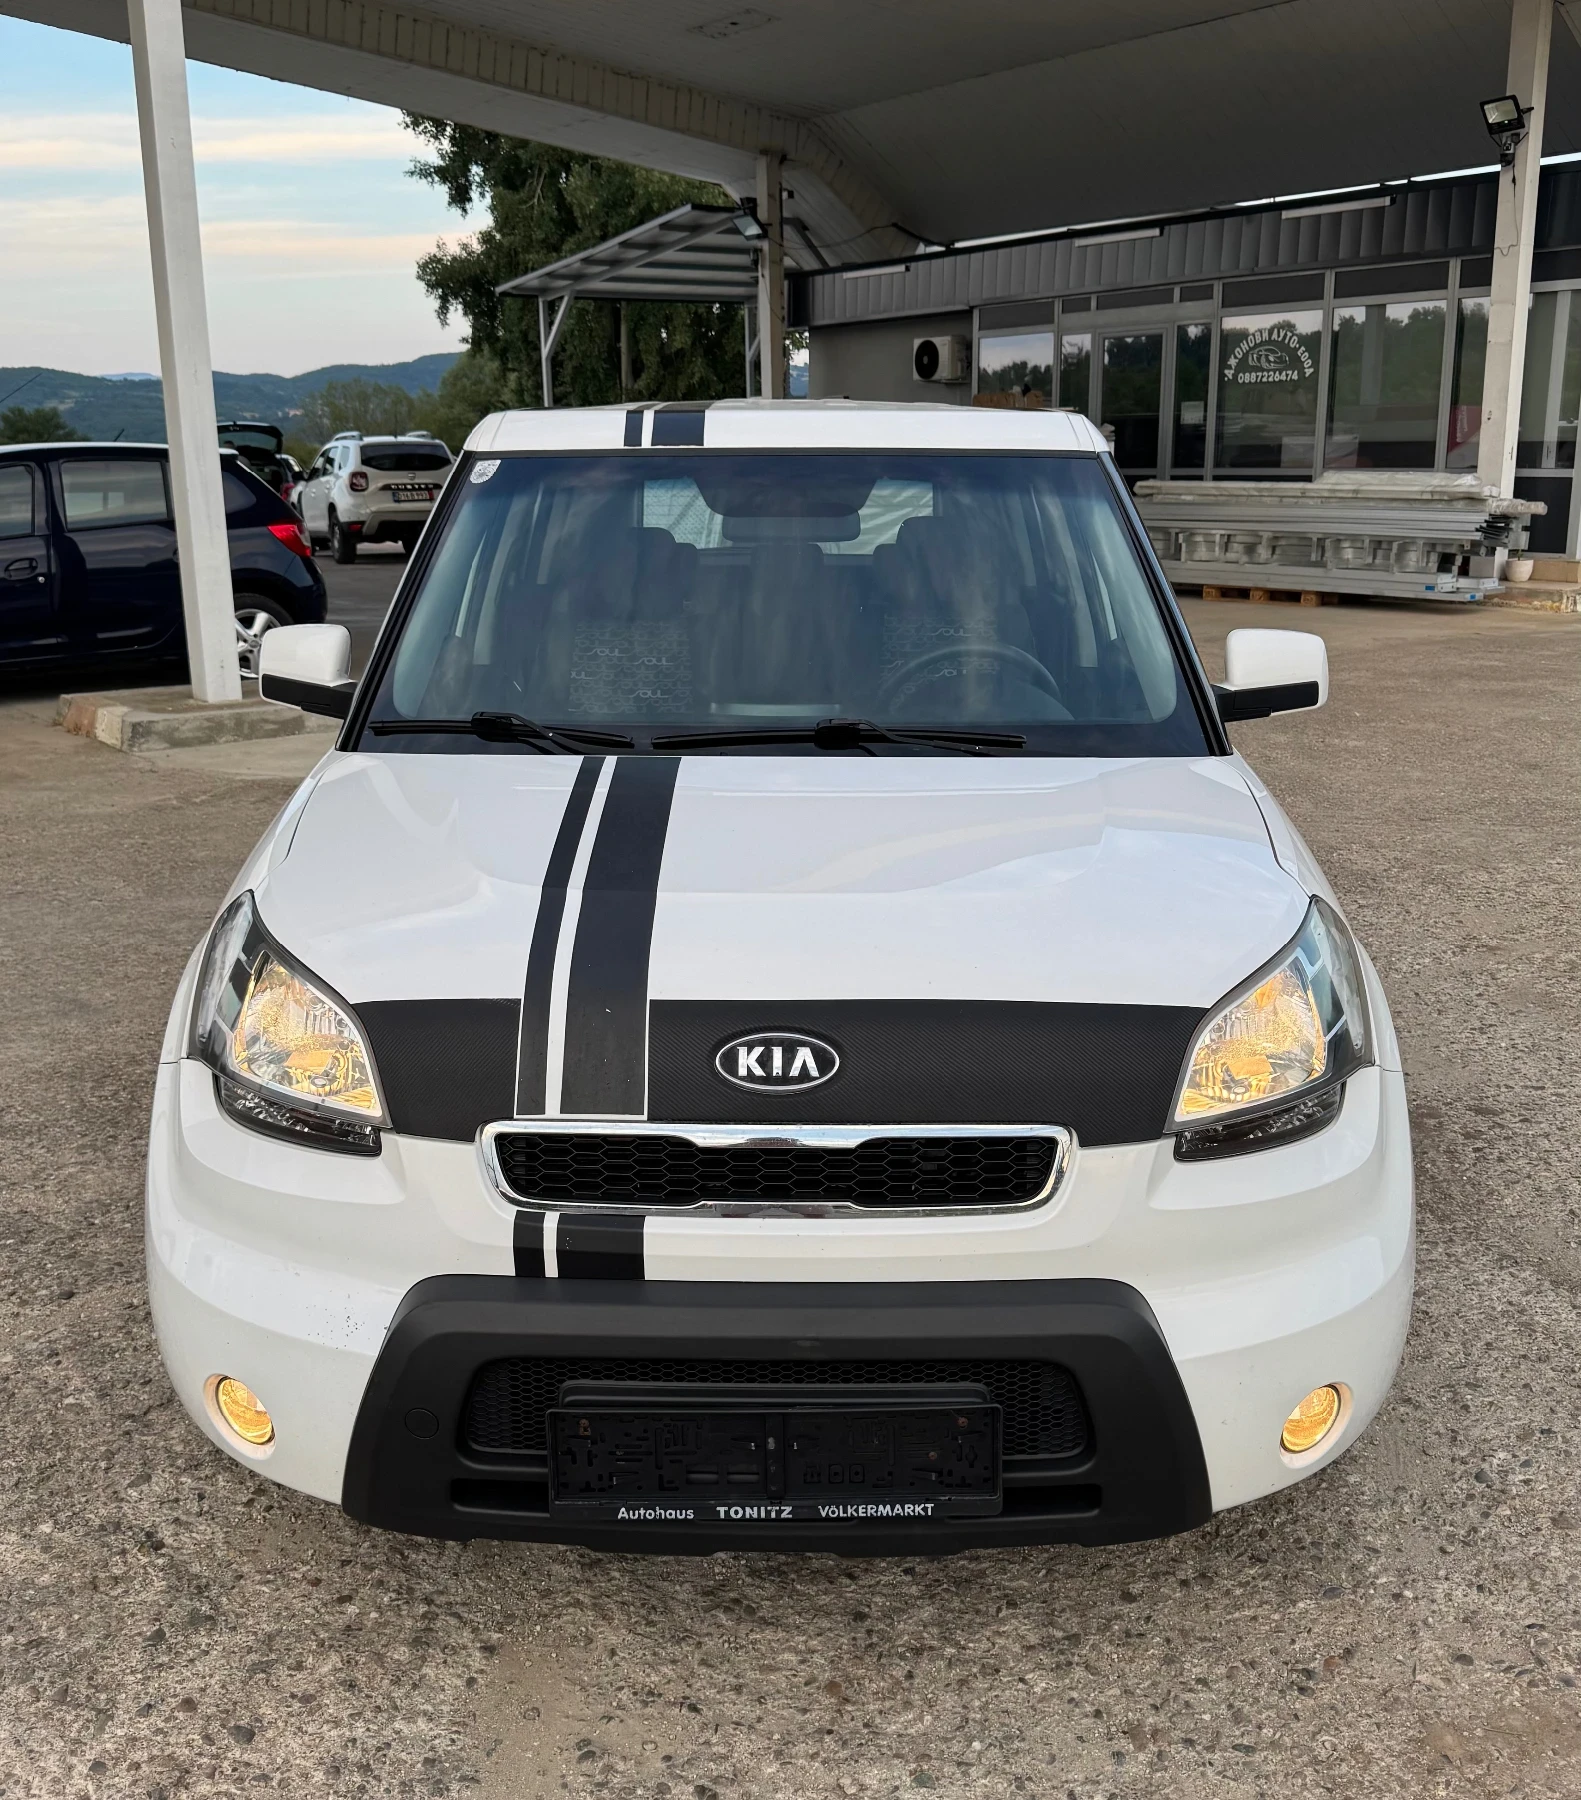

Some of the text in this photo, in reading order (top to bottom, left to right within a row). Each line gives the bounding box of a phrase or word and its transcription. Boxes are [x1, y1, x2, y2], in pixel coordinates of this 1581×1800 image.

[1238, 370, 1298, 383] 0887226474
[736, 1046, 820, 1078] KIA
[617, 1503, 935, 1520] Autohaus TONITZ VÖLKERMARKT
